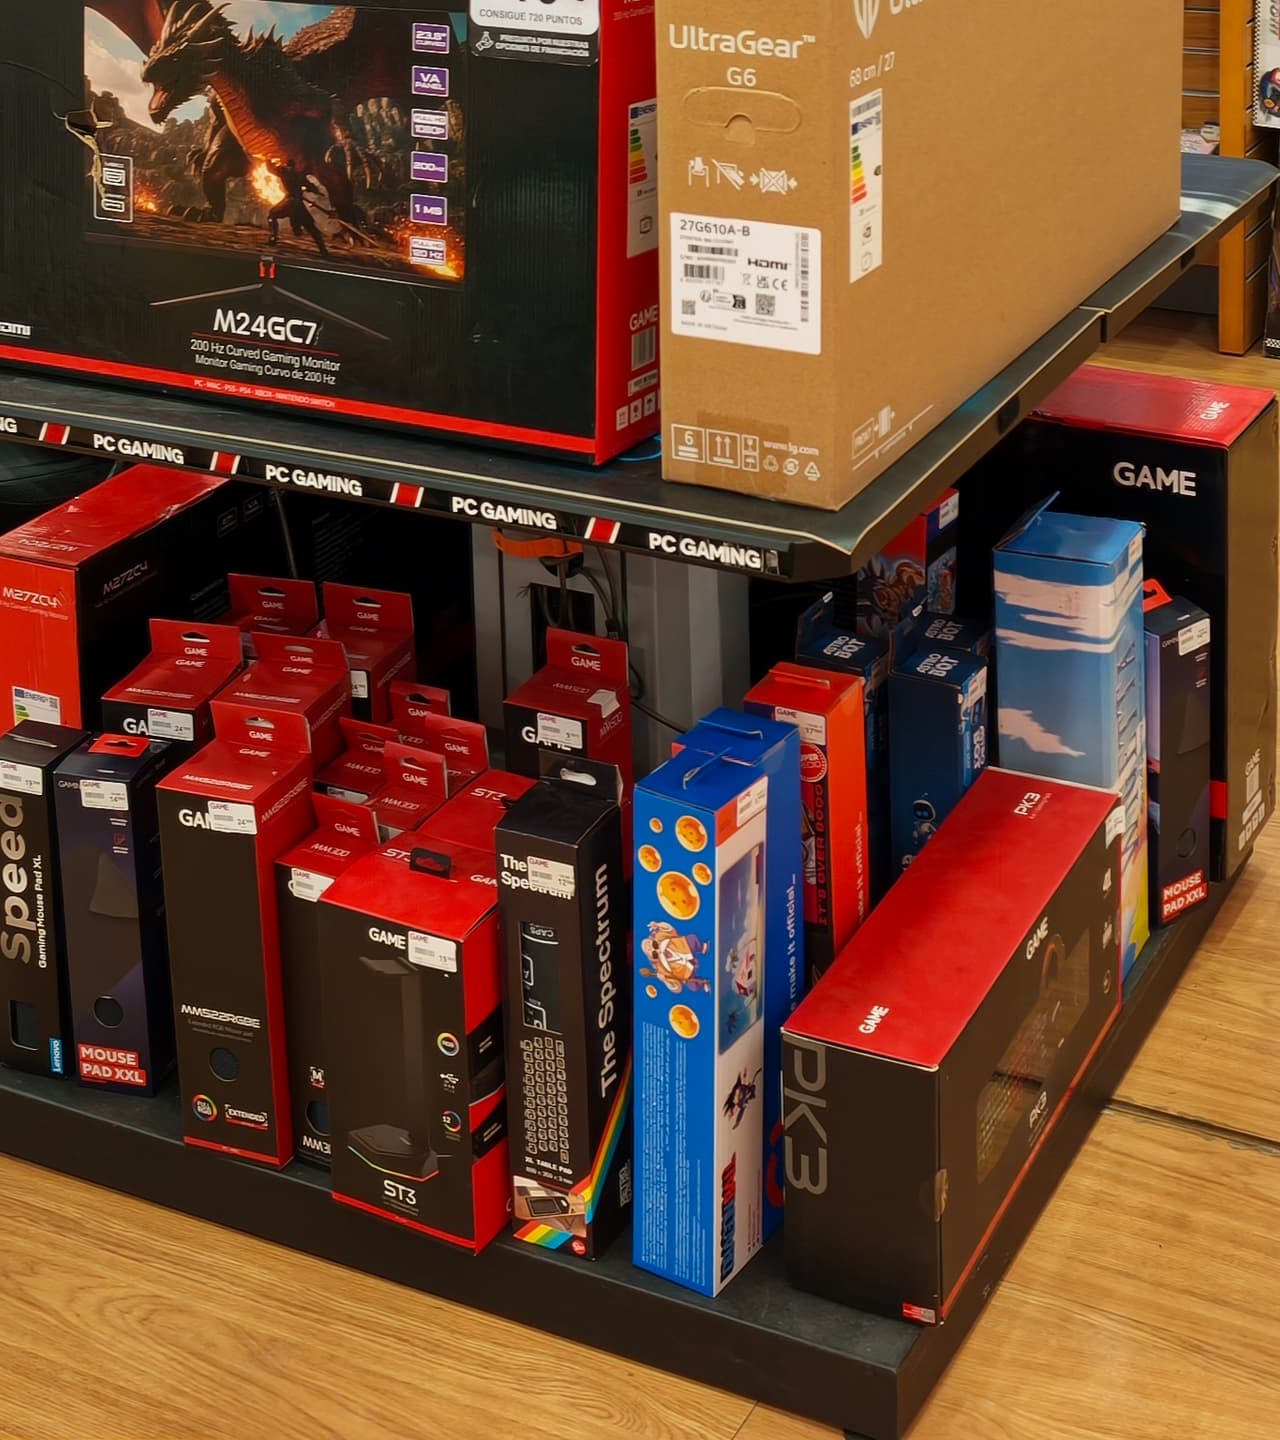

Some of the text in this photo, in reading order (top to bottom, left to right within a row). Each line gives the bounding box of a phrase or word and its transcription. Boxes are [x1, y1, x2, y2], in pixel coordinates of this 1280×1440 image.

[479, 9, 583, 25] CONSIGUE 720 PUNTOS
[416, 39, 446, 47] CURVED
[495, 43, 528, 52] OPCIONES
[500, 34, 589, 49] PREGUNTA POR NUESTRAS
[420, 73, 440, 83] VA
[726, 67, 756, 87] G6
[849, 67, 861, 87] 68
[863, 63, 875, 82] cm
[884, 51, 895, 71] 27
[415, 81, 446, 91] PANEL
[415, 124, 445, 135] 1080P
[680, 219, 750, 237] 27G610A-B
[213, 308, 318, 345] M24GC7
[190, 339, 341, 371] 200 Hz Curved Gaming Monitor
[195, 354, 336, 385] Monitor Gaming Curvo de 200 Hz
[92, 433, 185, 467] PC GAMING
[763, 440, 819, 455] www.lg.com
[264, 463, 363, 498] PC GAMING
[1114, 461, 1197, 497] GAME
[450, 495, 557, 533] PC GAMING
[647, 532, 762, 572] PC GAMING
[3, 586, 57, 608] M27ZC4
[1015, 791, 1041, 818] PK3
[500, 854, 526, 872] The
[1163, 871, 1202, 901] MOUSE
[33, 854, 47, 969] Gaming Mouse Pad XL
[1163, 885, 1205, 917] PAD XXL
[596, 863, 618, 1098] The Spectrum
[858, 1006, 890, 1035] GAME
[80, 1045, 136, 1066] MOUSE
[82, 1063, 144, 1083] PAD XXL
[783, 1036, 828, 1196] PK3
[537, 1158, 558, 1172] TABLE
[558, 1166, 572, 1175] PAD
[383, 1179, 417, 1206] ST3
